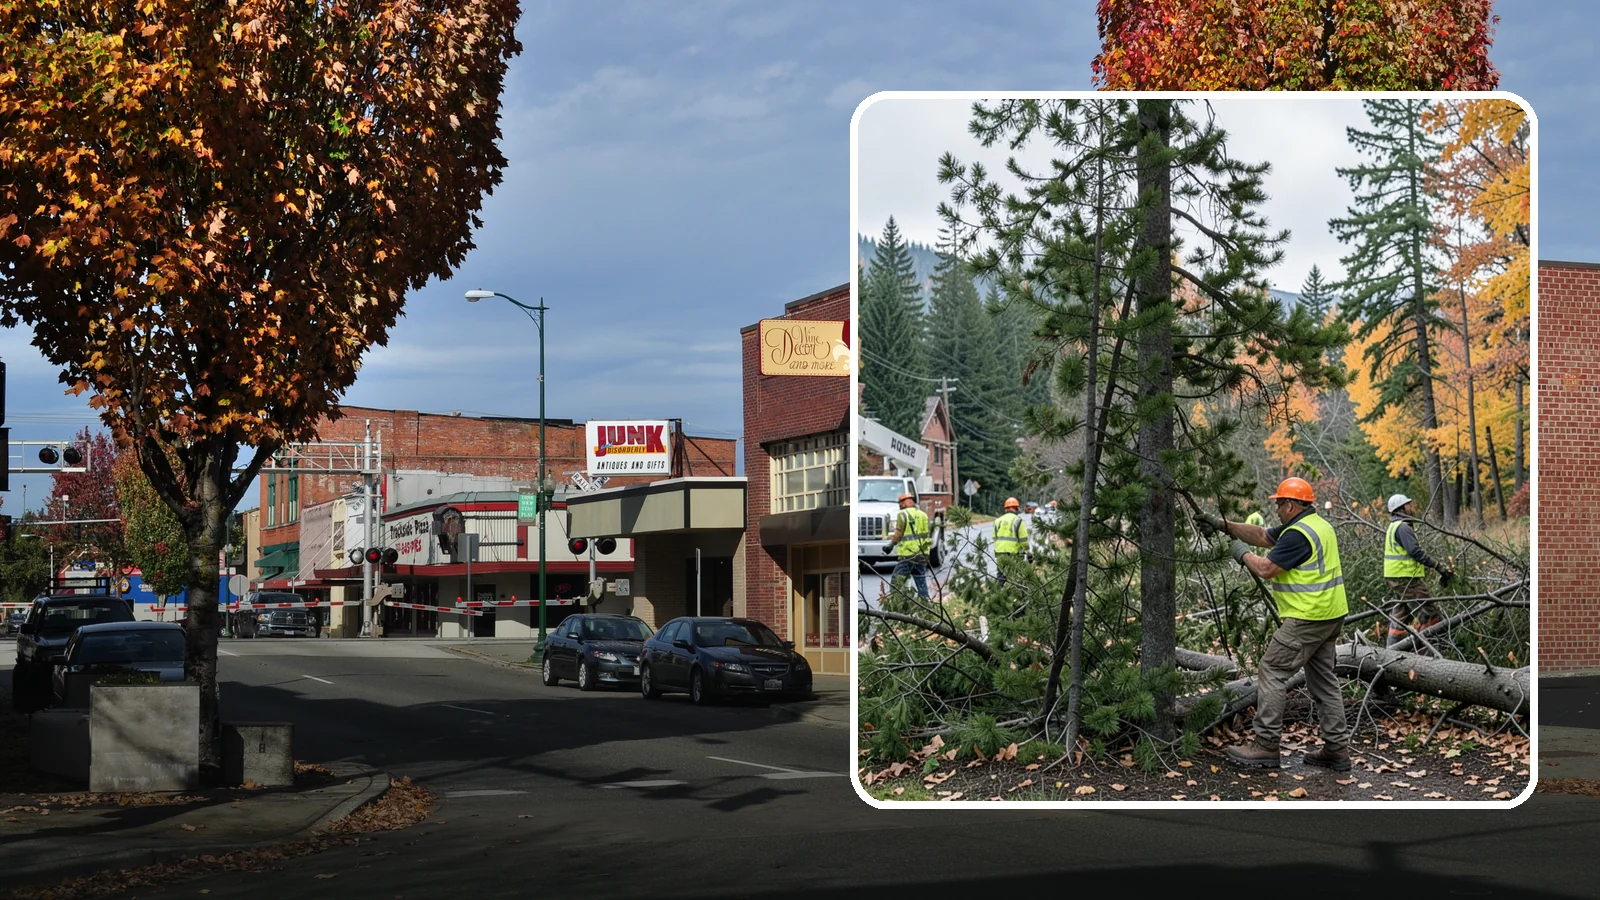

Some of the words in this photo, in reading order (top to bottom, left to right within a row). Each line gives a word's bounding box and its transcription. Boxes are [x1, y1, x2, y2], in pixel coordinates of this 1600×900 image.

[765, 328, 830, 365] Decor
[595, 425, 665, 457] JUNK
[607, 446, 646, 454] DISORDERLY
[597, 461, 628, 470] ANTIQUES
[631, 461, 644, 470] AND
[647, 461, 666, 470] GIFTS
[390, 521, 413, 540] Trackside
[415, 519, 429, 536] Pizza
